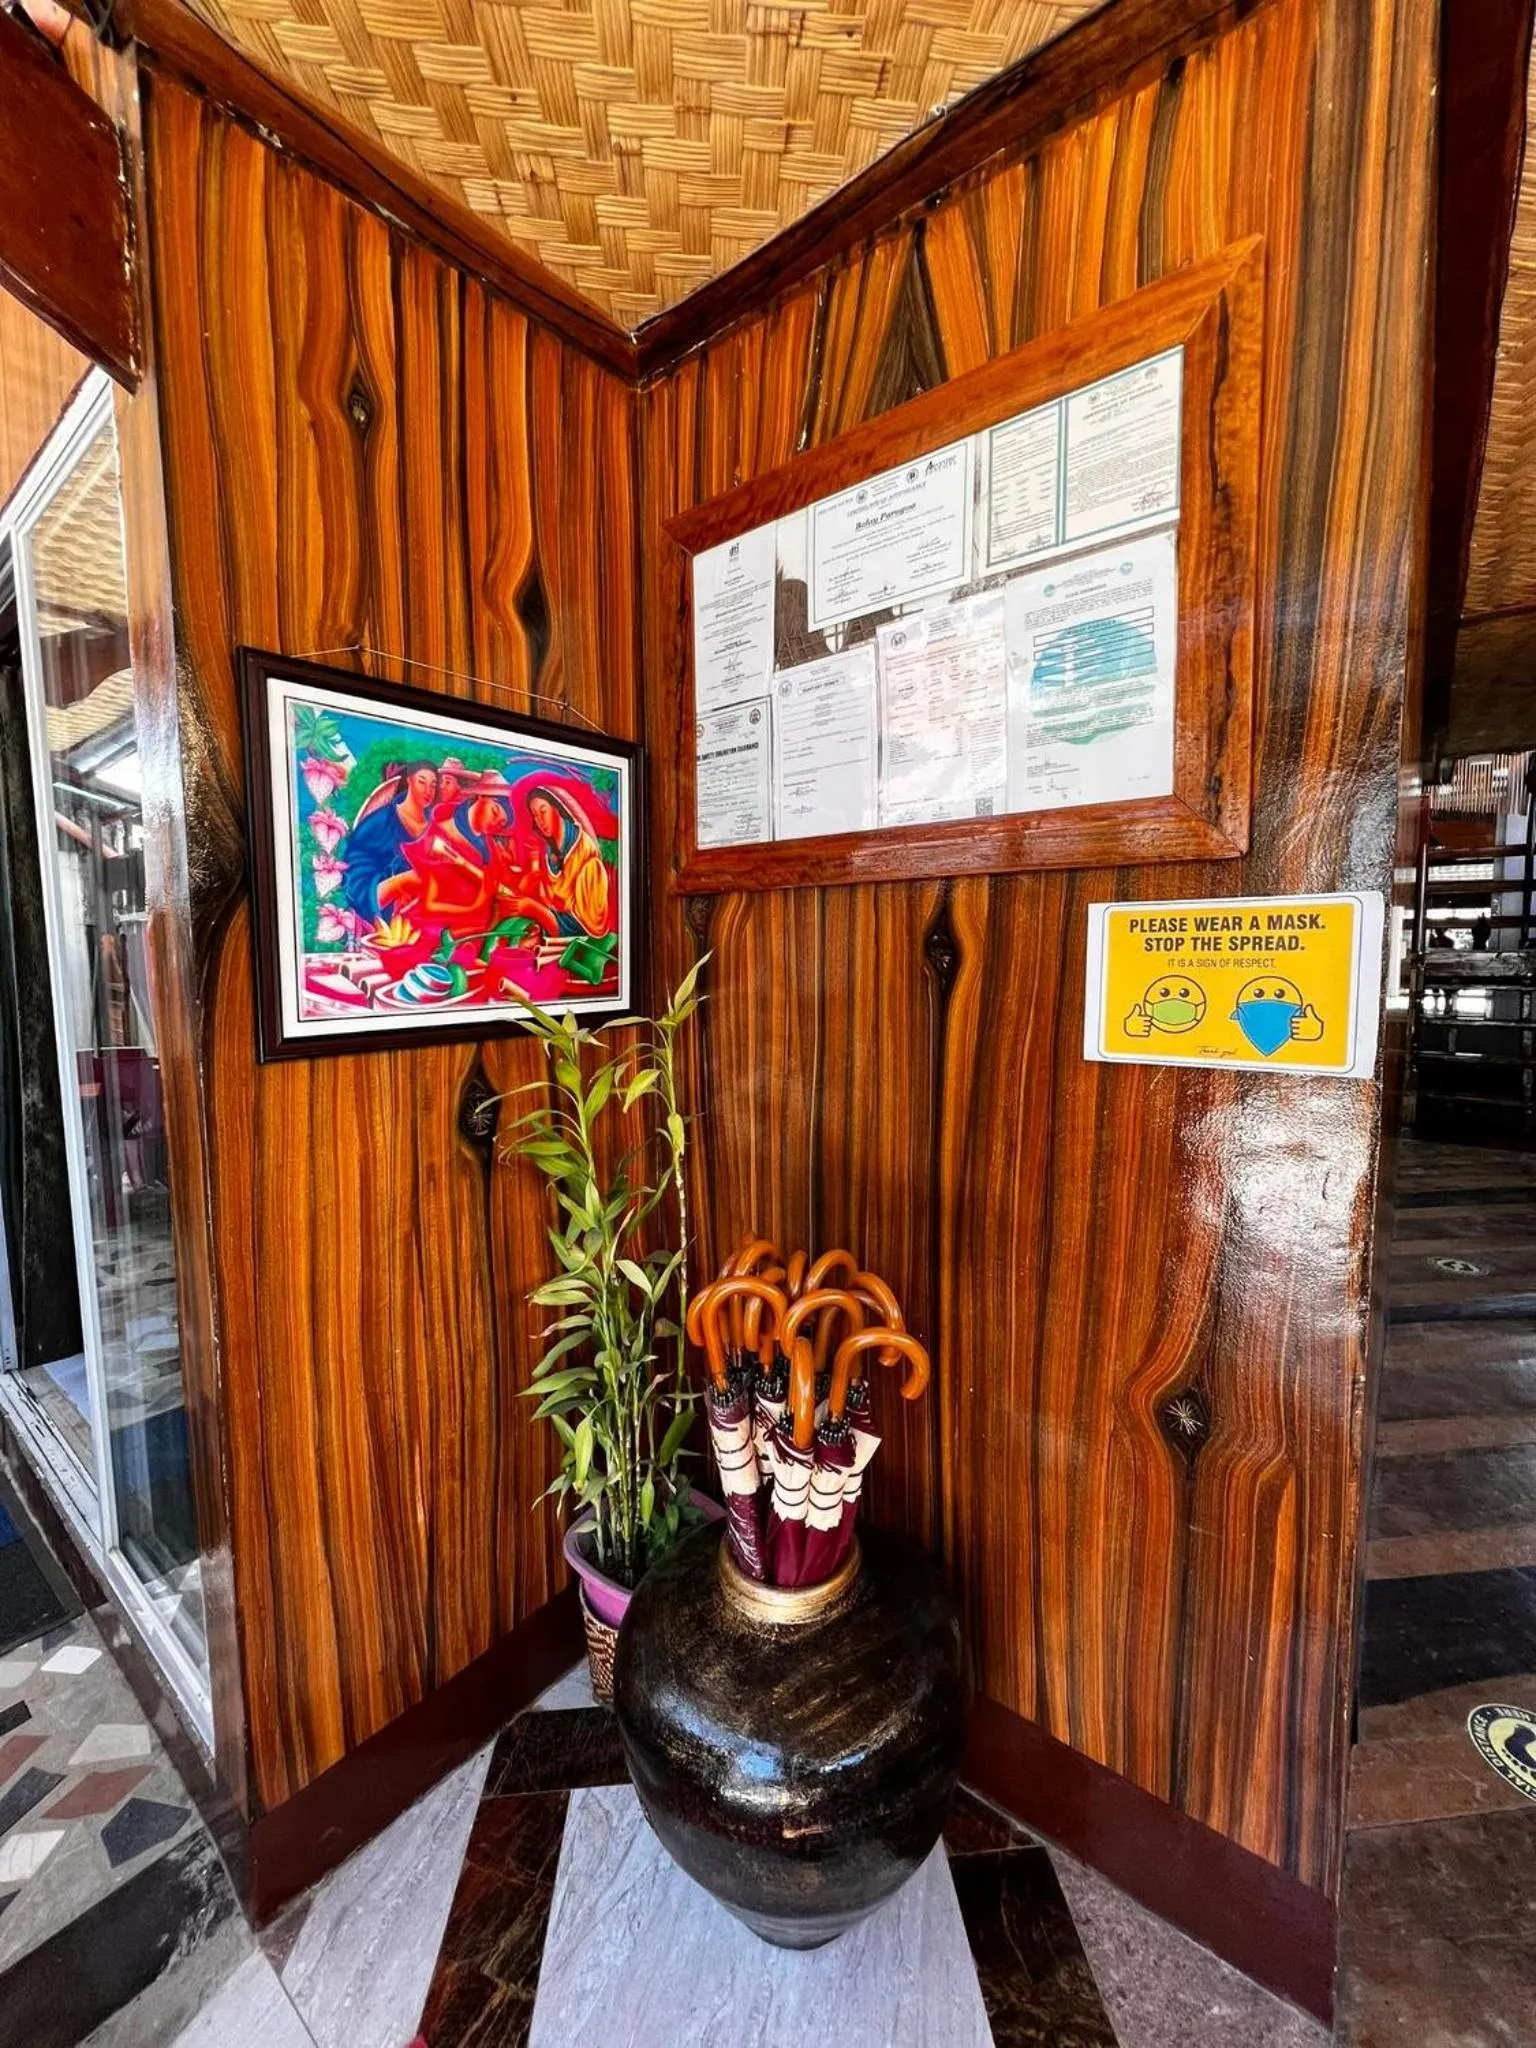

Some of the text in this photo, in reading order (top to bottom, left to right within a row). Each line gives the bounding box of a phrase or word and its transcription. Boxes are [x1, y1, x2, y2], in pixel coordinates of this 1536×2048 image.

[1129, 913, 1326, 933] PLEASE WEAR A MASK.
[1144, 935, 1306, 952] STOP THE SPREAD.
[1168, 958, 1176, 968] IT
[1178, 958, 1186, 968] IS
[1187, 958, 1194, 968] A
[1196, 958, 1217, 968] SIGN
[1219, 958, 1230, 968] OF
